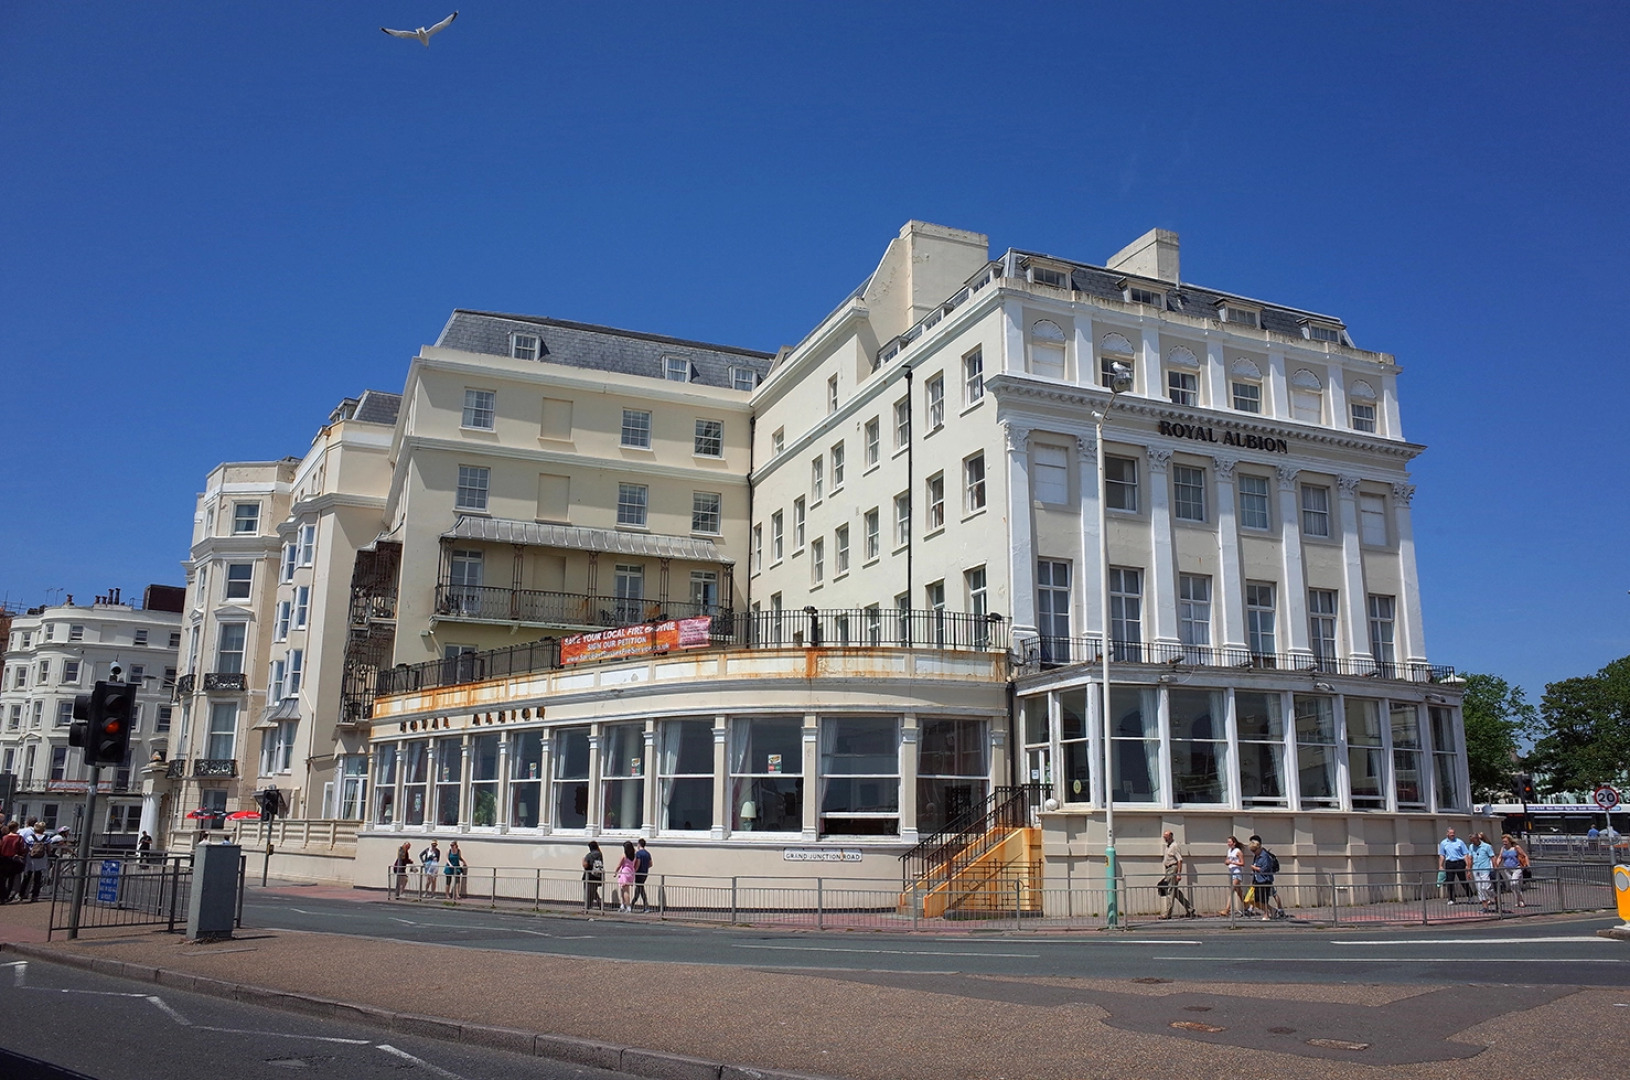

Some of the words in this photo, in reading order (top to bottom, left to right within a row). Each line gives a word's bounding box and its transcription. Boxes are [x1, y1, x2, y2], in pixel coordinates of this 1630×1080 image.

[1159, 420, 1218, 443] ROYAL
[1223, 430, 1288, 454] ALBION
[583, 633, 601, 643] YOUR
[603, 628, 625, 640] LOCAL
[587, 642, 602, 651] SIGN
[603, 640, 616, 649] OUR
[617, 637, 647, 647] PETITION
[1597, 792, 1615, 802] 20
